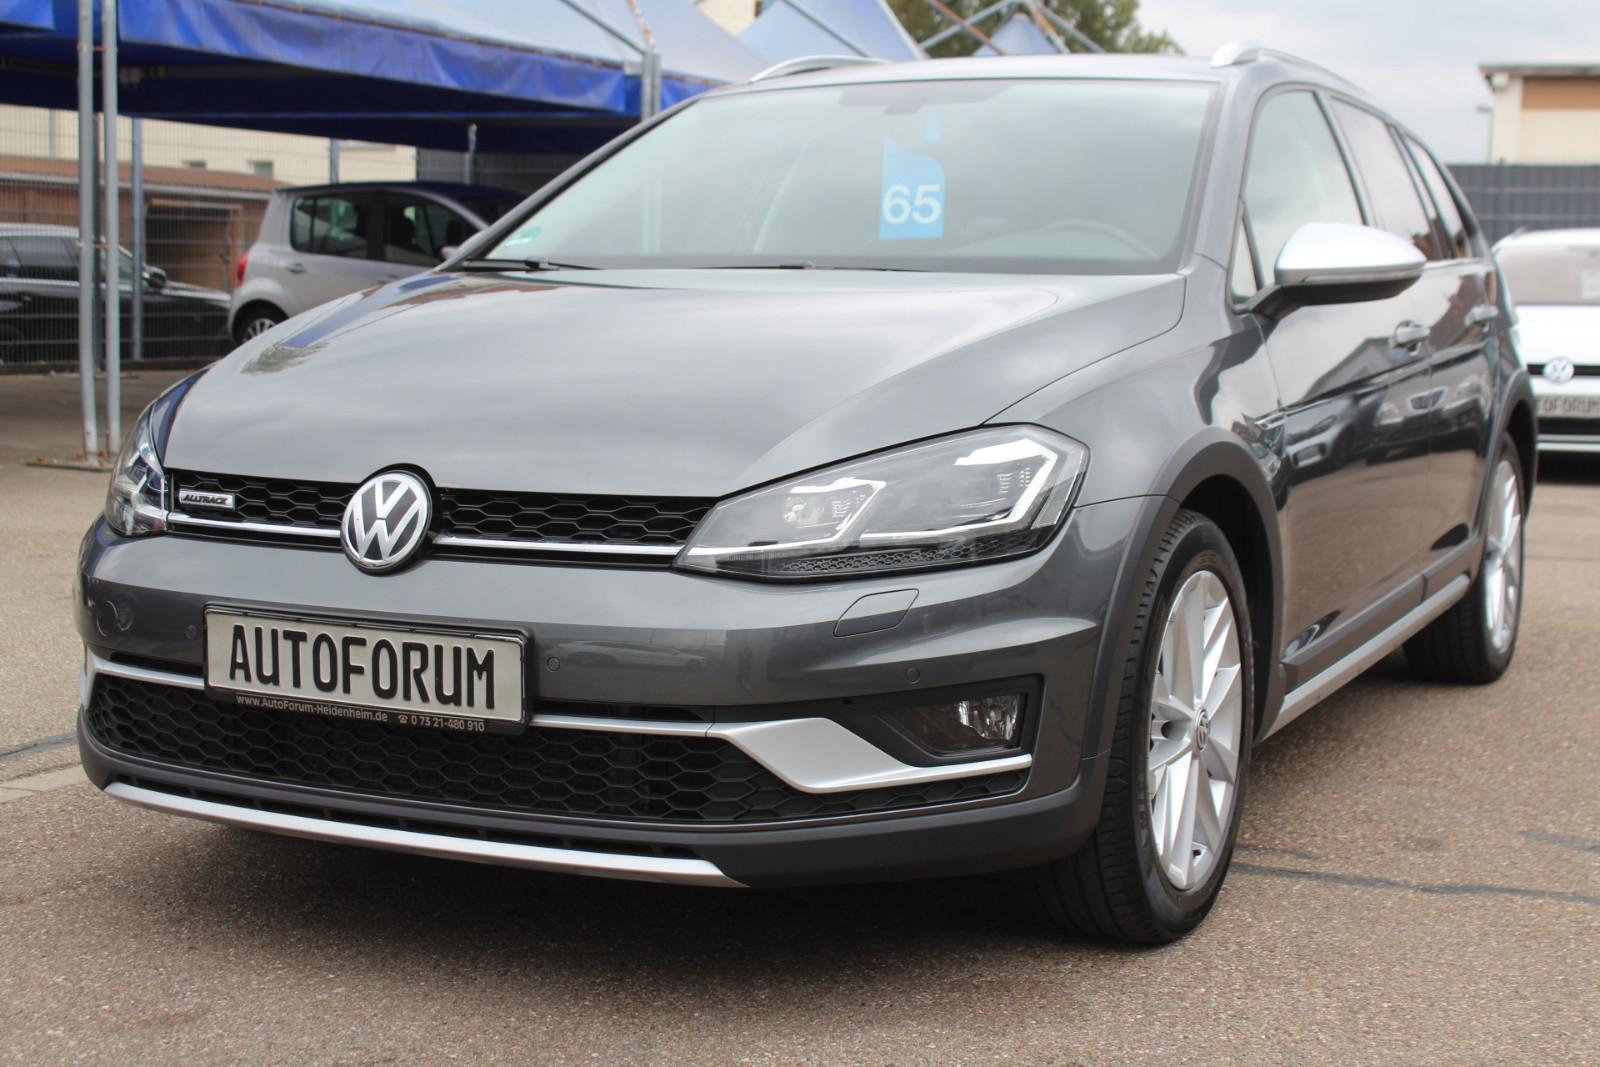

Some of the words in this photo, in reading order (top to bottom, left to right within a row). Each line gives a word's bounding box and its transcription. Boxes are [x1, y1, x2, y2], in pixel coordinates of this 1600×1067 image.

[882, 184, 942, 225] 65
[182, 494, 228, 505] ALLTRACK
[229, 624, 495, 709] AUTOFORUM
[235, 695, 388, 722] www.AutoForum-Heidenheim.de
